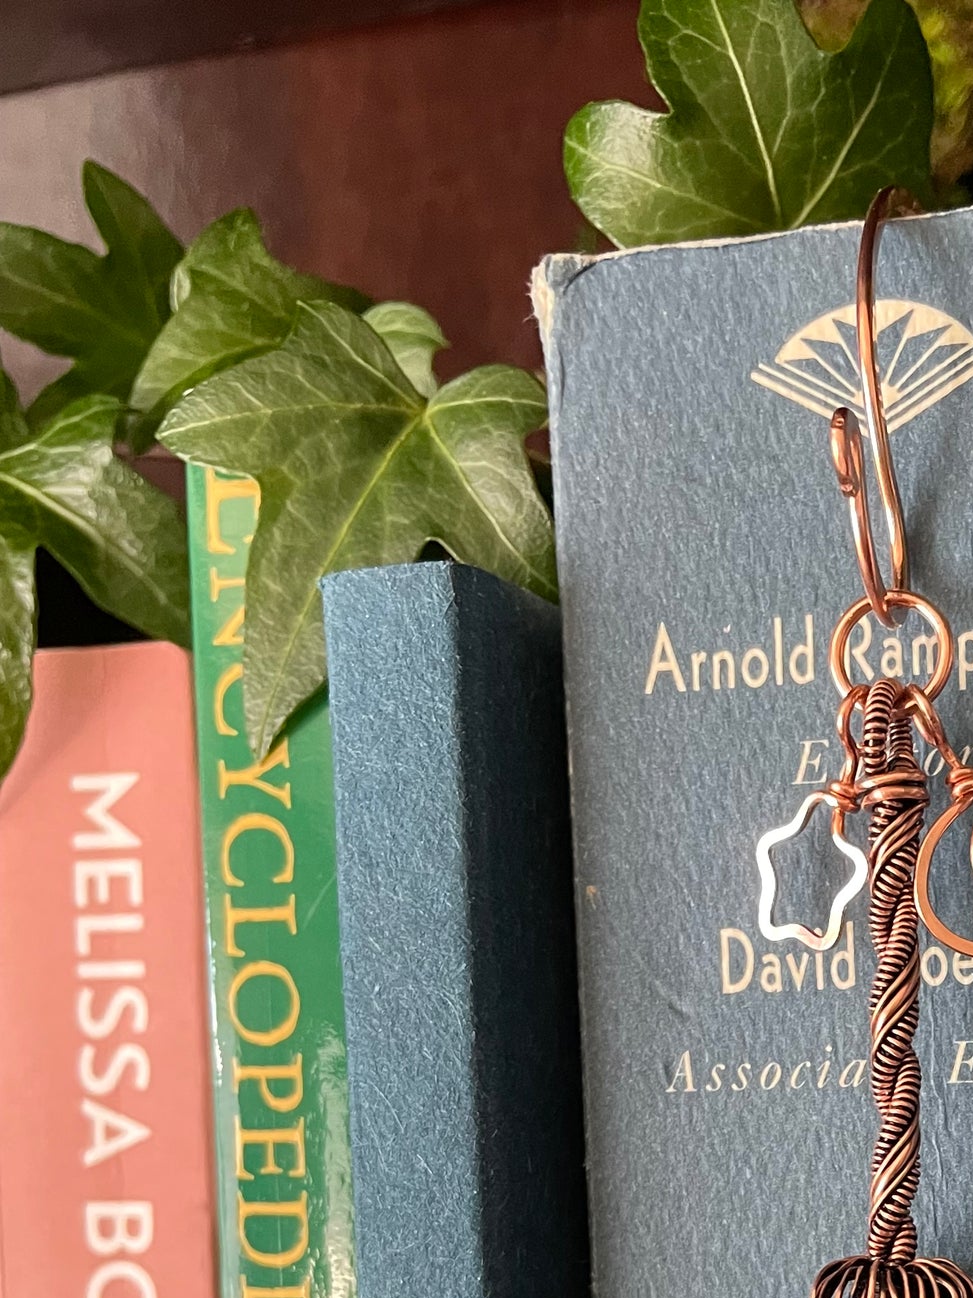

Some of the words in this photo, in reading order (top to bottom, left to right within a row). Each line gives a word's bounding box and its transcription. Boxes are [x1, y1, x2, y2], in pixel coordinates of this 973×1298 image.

[644, 614, 815, 695] Arnold
[69, 771, 151, 1167] MELISSA
[720, 920, 856, 995] David
[666, 1045, 867, 1093] Associa
